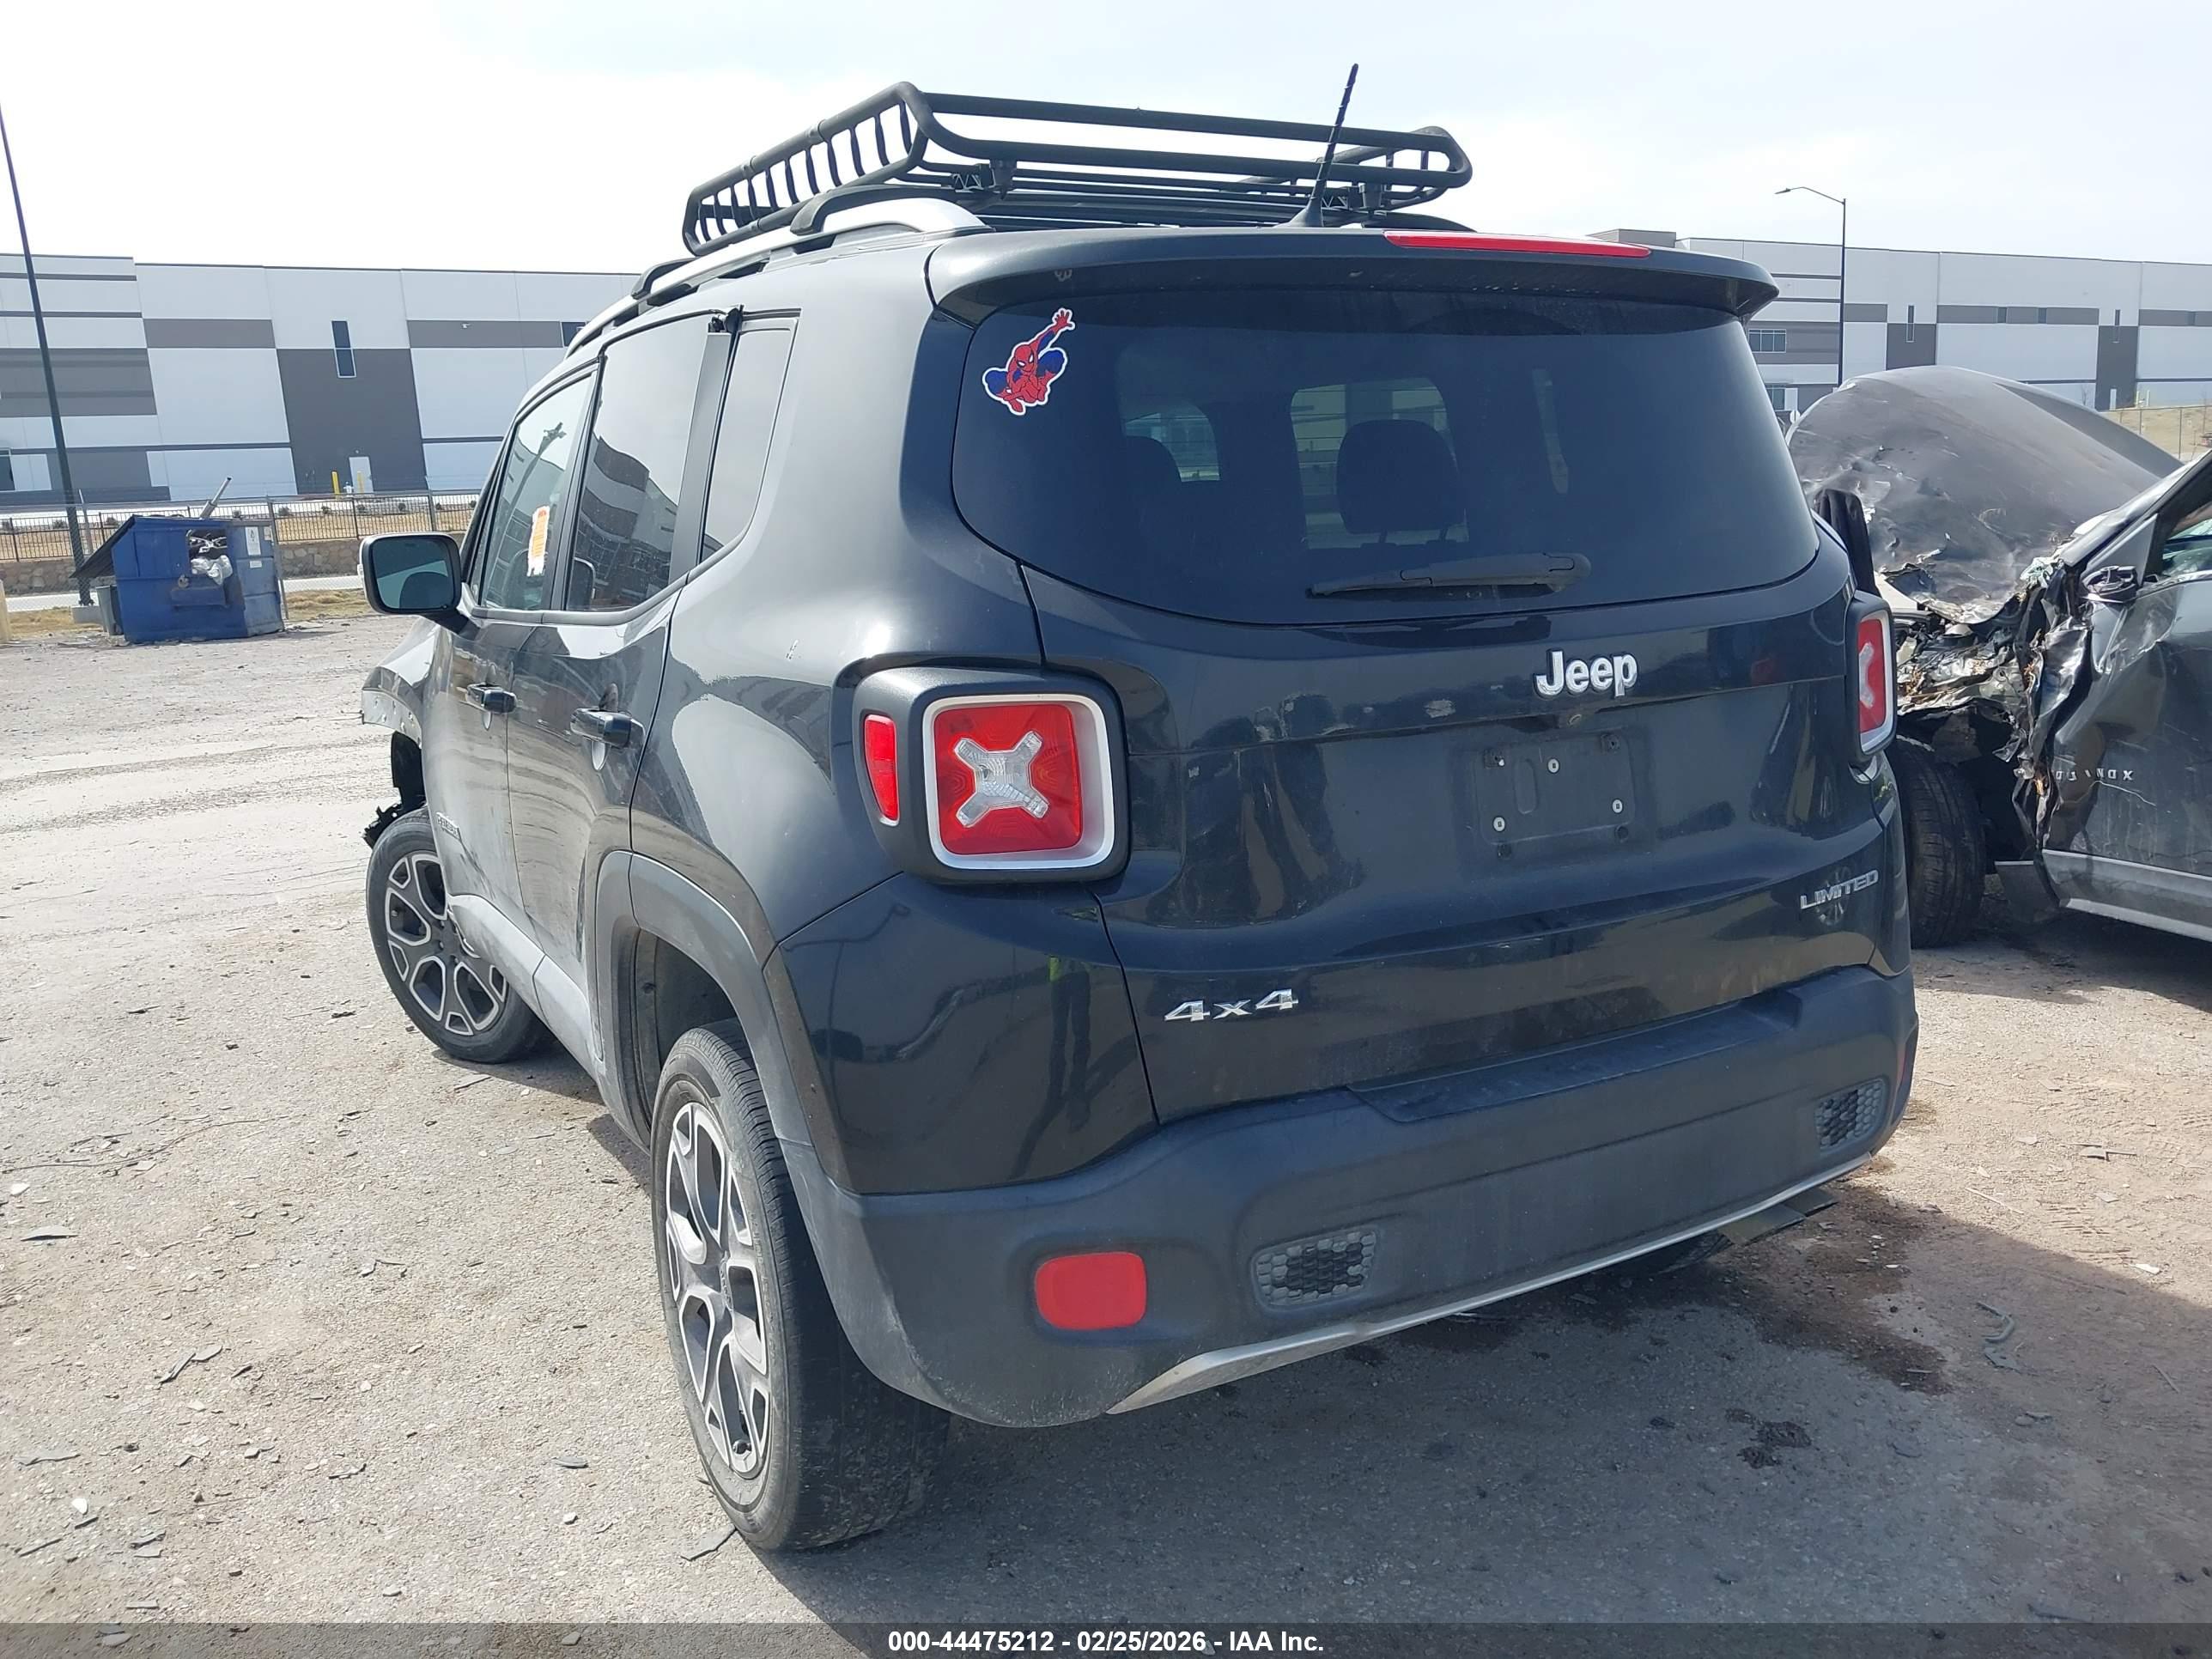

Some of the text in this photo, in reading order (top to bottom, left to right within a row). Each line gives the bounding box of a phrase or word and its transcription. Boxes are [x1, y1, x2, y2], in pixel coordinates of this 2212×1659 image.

[1534, 650, 1638, 697] Jeep
[1800, 869, 1879, 909] LIMITED
[1164, 988, 1299, 1023] 4x4
